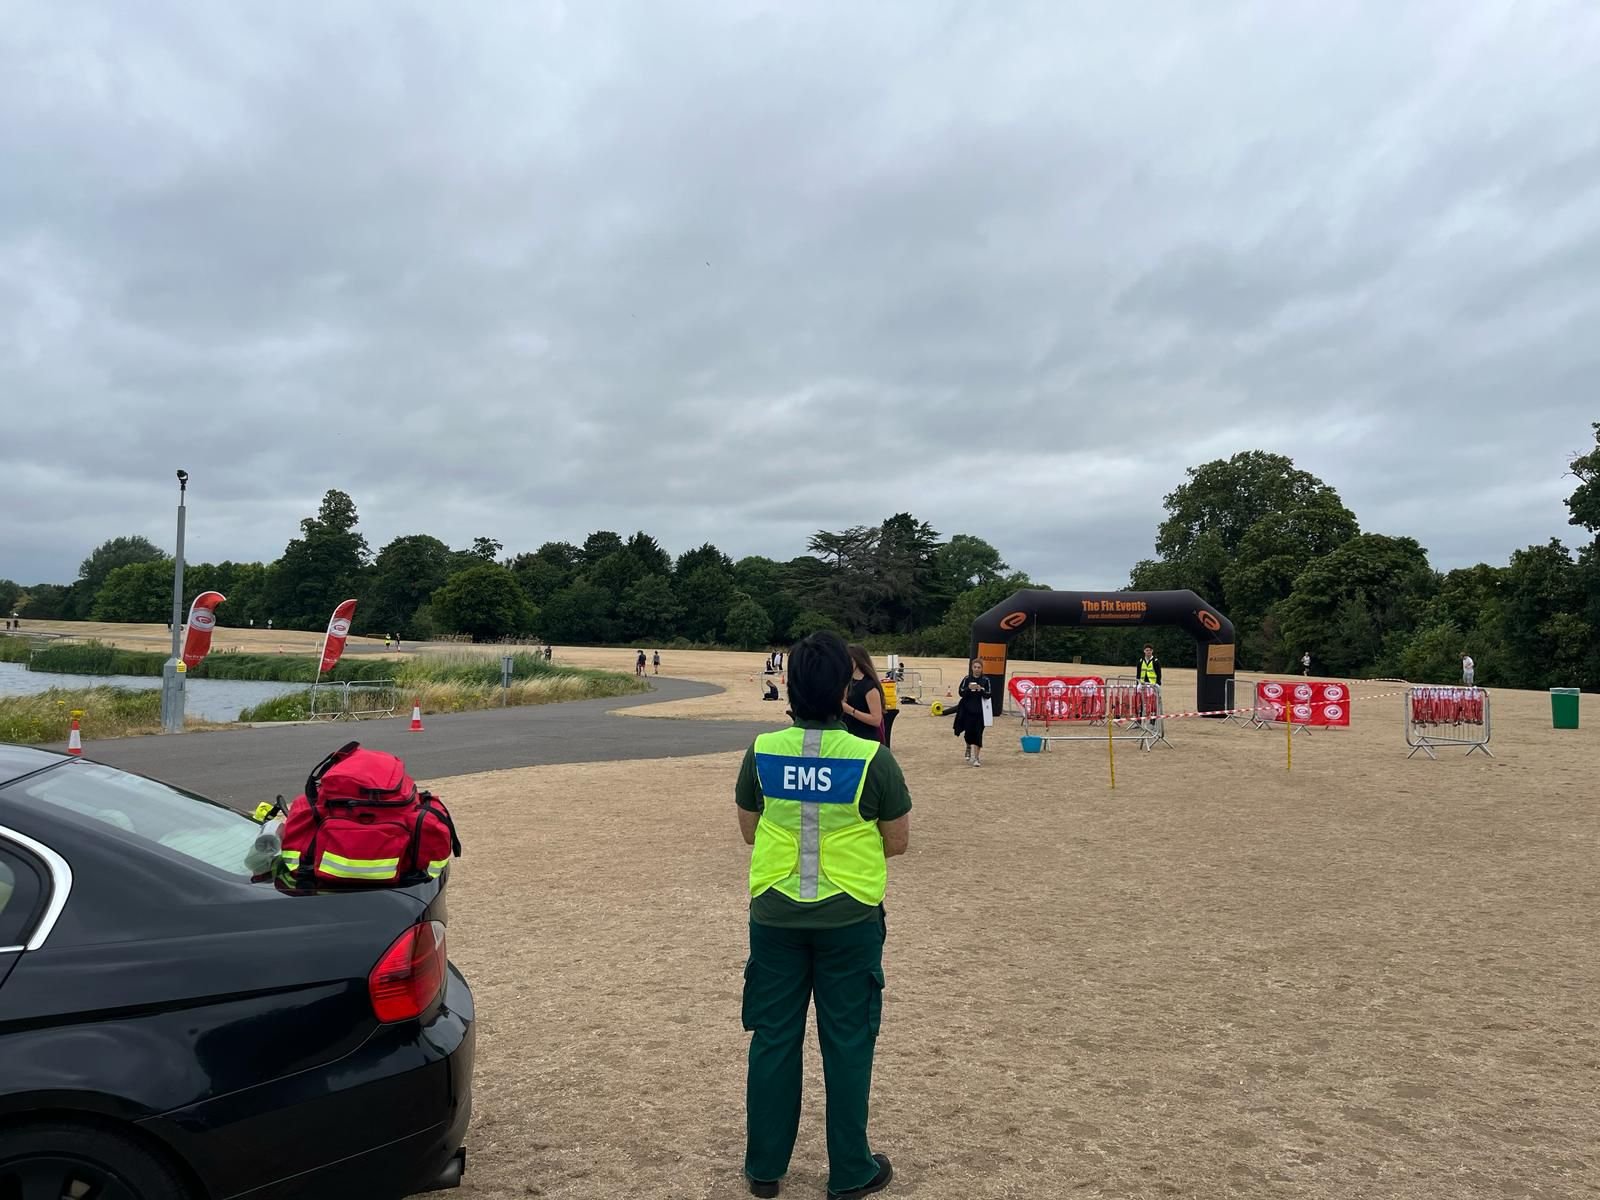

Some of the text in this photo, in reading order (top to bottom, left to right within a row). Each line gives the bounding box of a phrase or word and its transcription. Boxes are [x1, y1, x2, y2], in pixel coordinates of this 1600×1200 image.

[1081, 600, 1147, 611] The Fix Events
[783, 765, 832, 792] EMS
